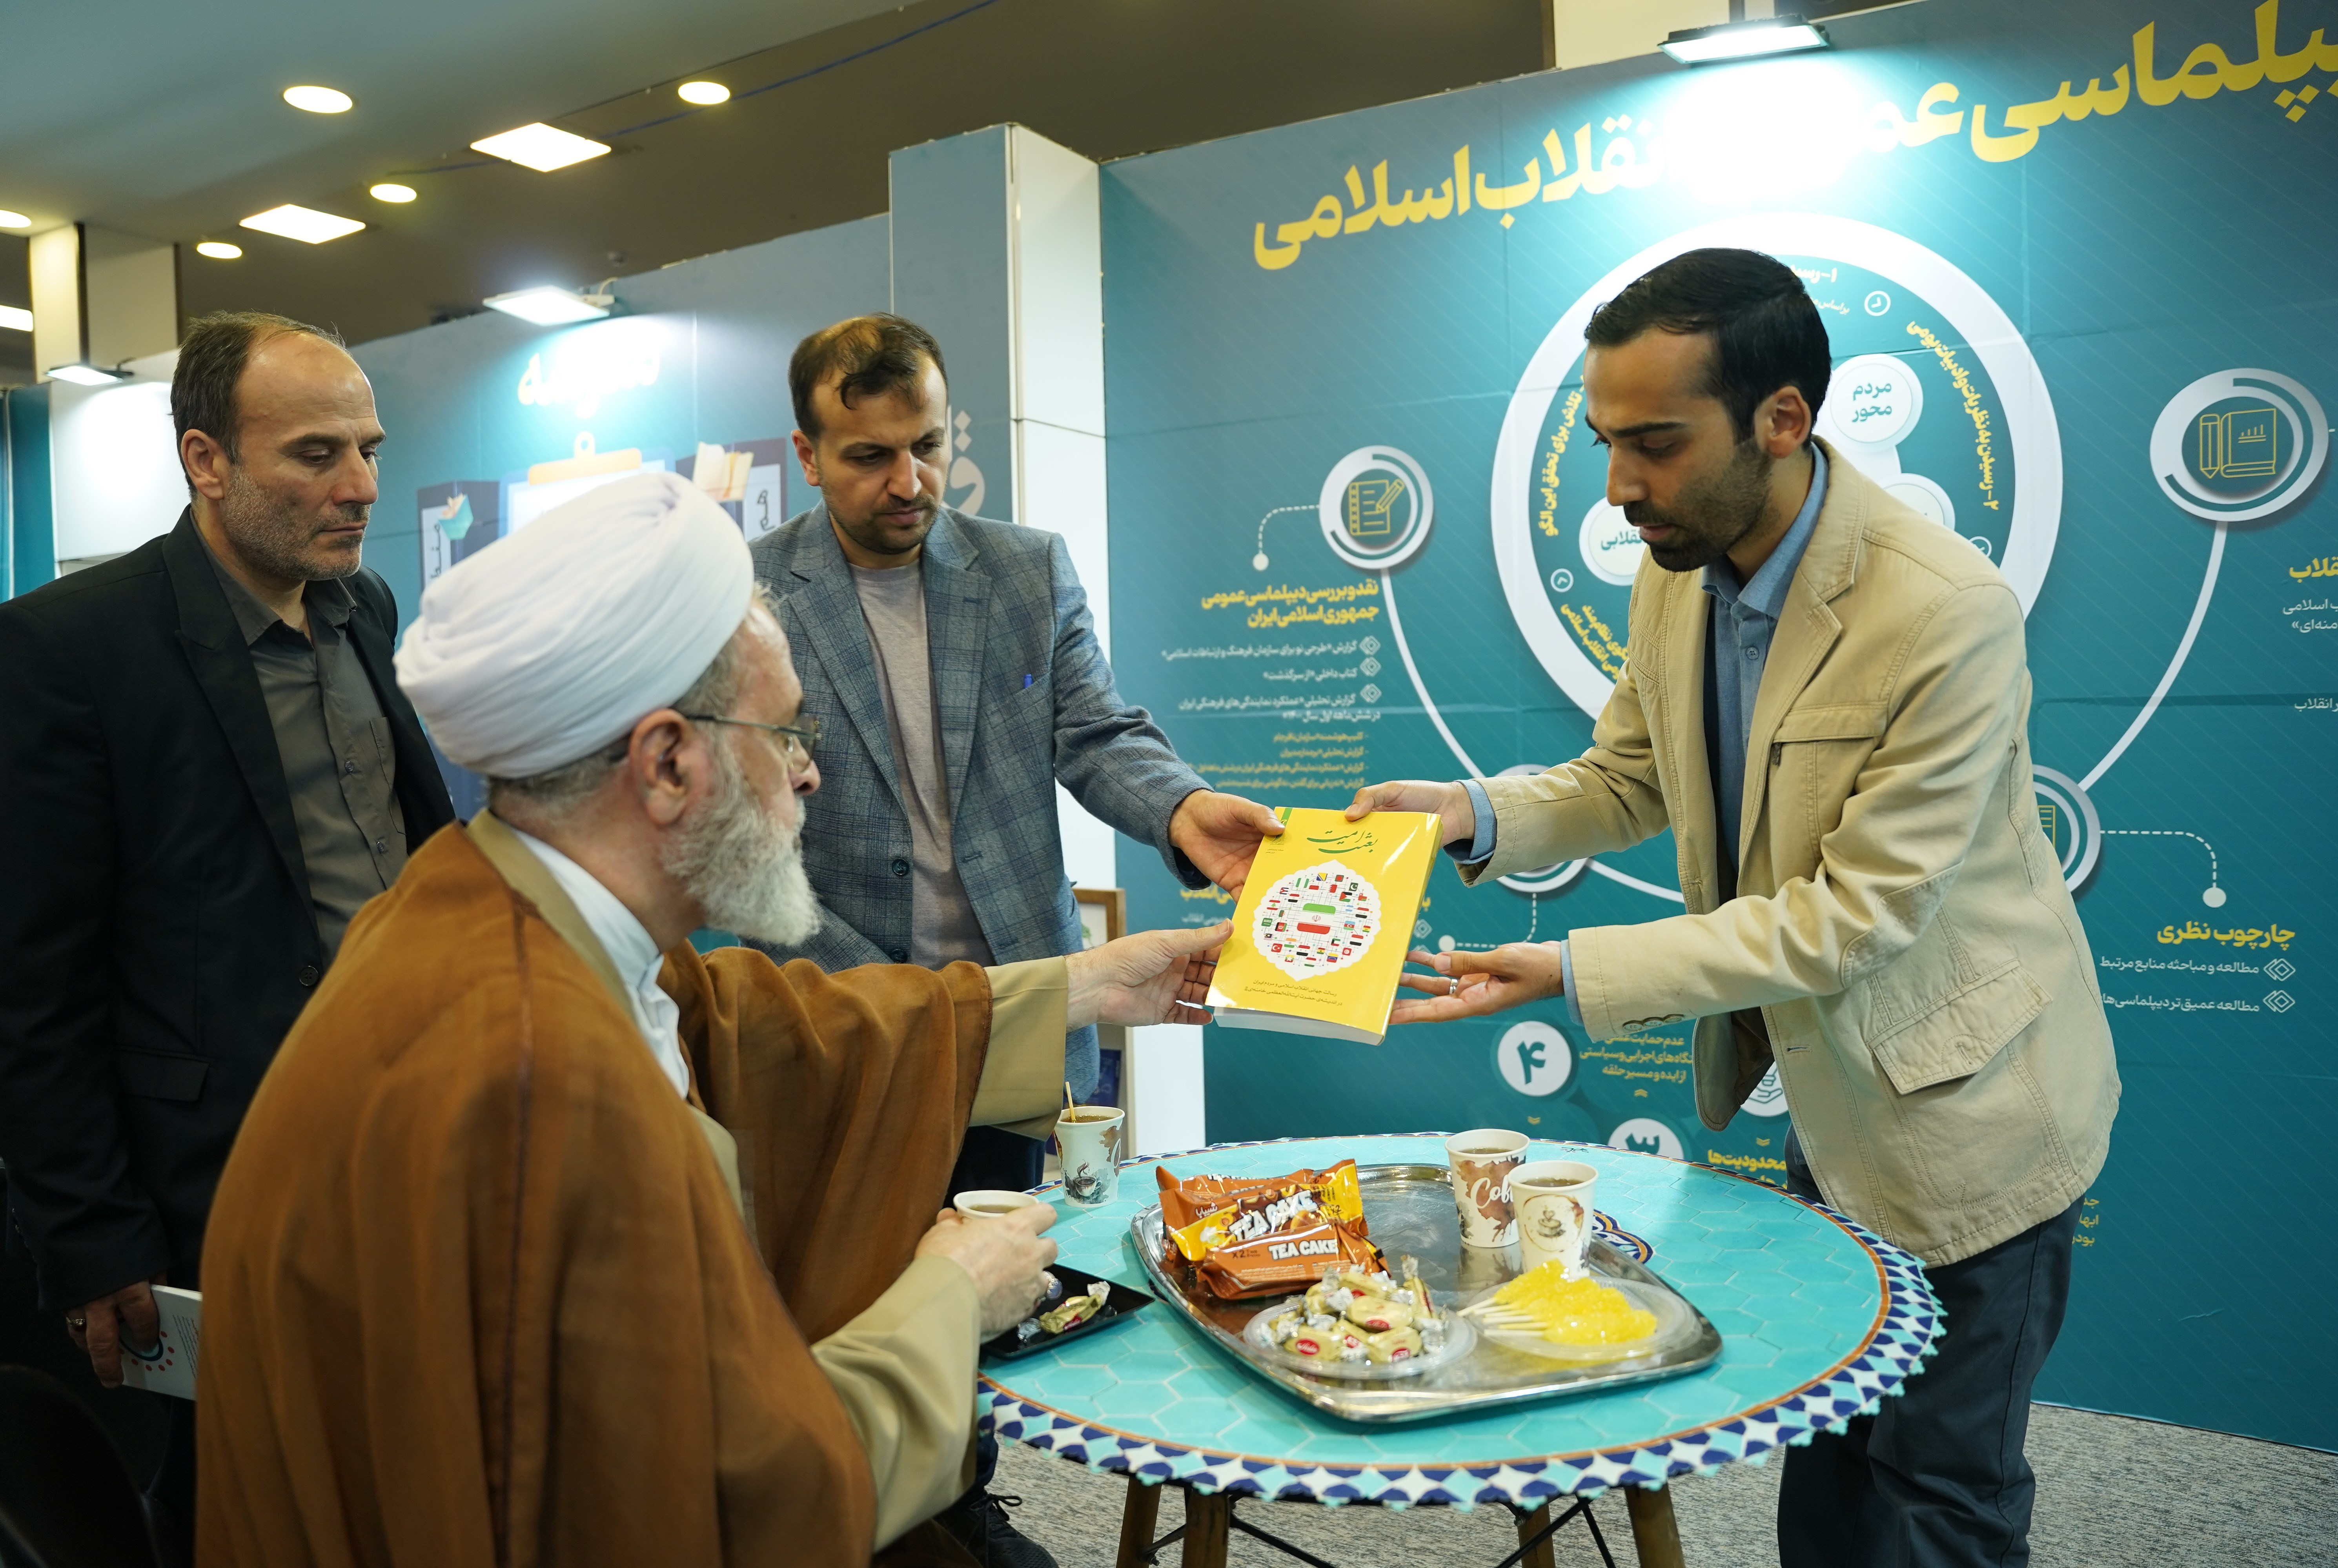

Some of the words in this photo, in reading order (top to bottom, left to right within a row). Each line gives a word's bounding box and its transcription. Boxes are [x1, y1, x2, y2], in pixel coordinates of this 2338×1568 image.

[1254, 144, 1470, 271] اسلامی
[1906, 321, 1941, 348] بومی
[1852, 381, 1892, 400] مردم
[1562, 391, 1582, 427] تلاش
[1852, 404, 1892, 423] محور
[1551, 426, 1570, 453] برای
[1542, 452, 1560, 488] تحقق
[1540, 488, 1557, 510] این
[1539, 510, 1559, 537] الگو
[1245, 584, 1306, 607] دیپلماسی
[1306, 585, 1347, 604] بررسی
[1356, 578, 1379, 595] نقد
[1201, 589, 1245, 610] عمومی
[2282, 598, 2329, 615] اسلامی
[1247, 607, 1278, 627] ایران
[1277, 604, 1324, 627] اسلامی
[1323, 606, 1379, 625] جمهوری
[1560, 604, 1590, 637] اسلامی
[1582, 634, 1610, 662] انقلاب
[2294, 697, 2333, 713] انقلاب
[2157, 920, 2211, 945] نظری
[2214, 923, 2296, 951] چارچوب
[2099, 956, 2134, 971] مرتبط
[2134, 958, 2166, 972] منابع
[2167, 958, 2207, 973] مباحثه
[2207, 963, 2215, 974] و
[2216, 962, 2260, 974] مطالعه
[2216, 1000, 2260, 1012] مطالعه
[1629, 1033, 1664, 1046] حمایت
[1663, 1037, 1684, 1049] عدم
[1517, 1040, 1546, 1084] ۴
[1229, 1209, 1271, 1241] TEA
[1266, 1189, 1320, 1227] CAKE
[1268, 1242, 1299, 1260] TEA
[1298, 1238, 1339, 1256] CAKE
